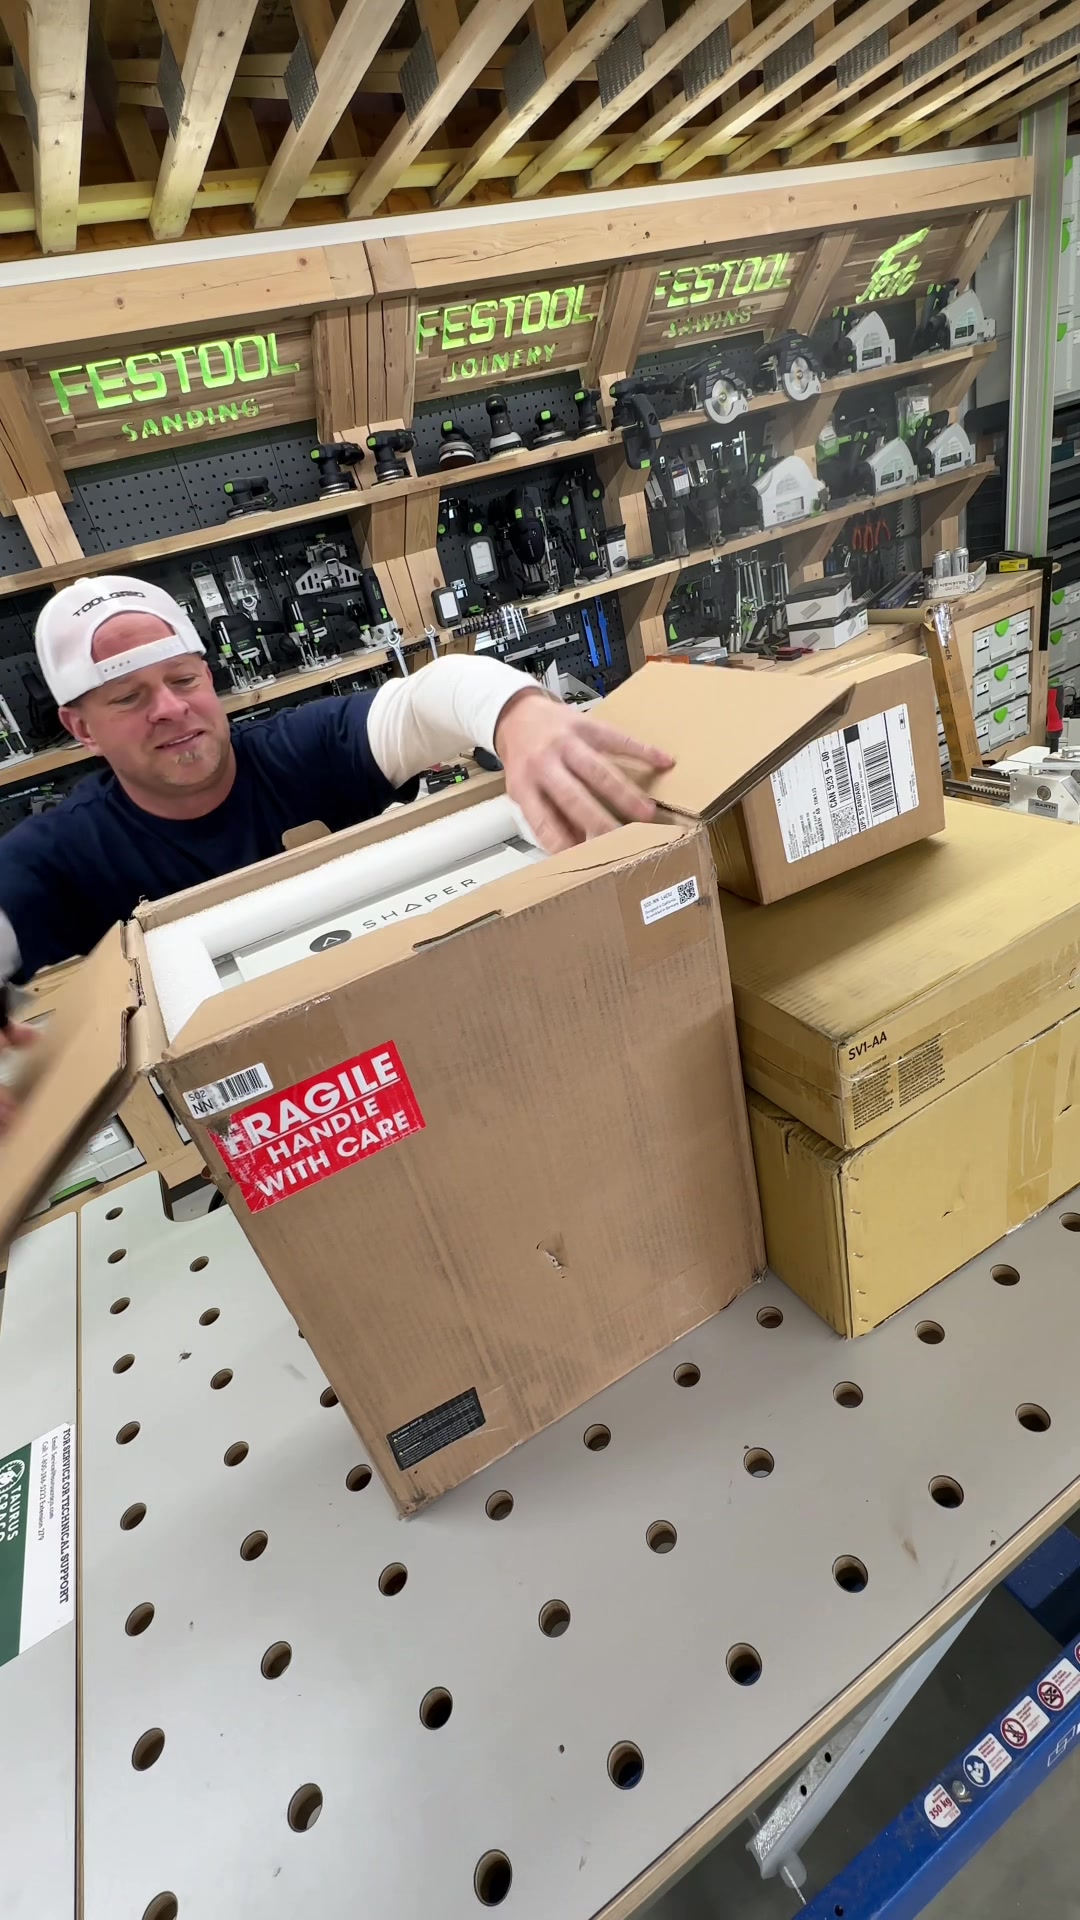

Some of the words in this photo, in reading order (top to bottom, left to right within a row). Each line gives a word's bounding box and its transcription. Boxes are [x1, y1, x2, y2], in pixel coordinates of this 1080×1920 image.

[654, 252, 791, 308] FESTOOL
[416, 284, 594, 354] FESTOOL
[49, 332, 300, 415] FESTOOL
[447, 343, 559, 382] JOINERY
[121, 398, 261, 442] SANDING
[826, 775, 835, 791] 523
[829, 791, 838, 808] CAN
[853, 781, 864, 816] STANDARD
[859, 815, 867, 831] UPS
[362, 878, 477, 929] SHAPER
[848, 1031, 887, 1060] SV1-AA
[192, 1099, 214, 1115] NN
[223, 1051, 398, 1156] FRAGILE
[266, 1096, 382, 1165] HANDLE
[256, 1150, 332, 1197] WITH
[336, 1109, 411, 1157] CARE
[62, 1428, 71, 1446] FOR
[61, 1446, 71, 1482] SERVICE
[61, 1482, 70, 1497] OR
[7, 1485, 22, 1541] TAURUS
[60, 1495, 70, 1555] TECHNICAL
[59, 1553, 70, 1604] SUPPORT
[929, 1803, 943, 1820] 350
[941, 1797, 953, 1808] kg
